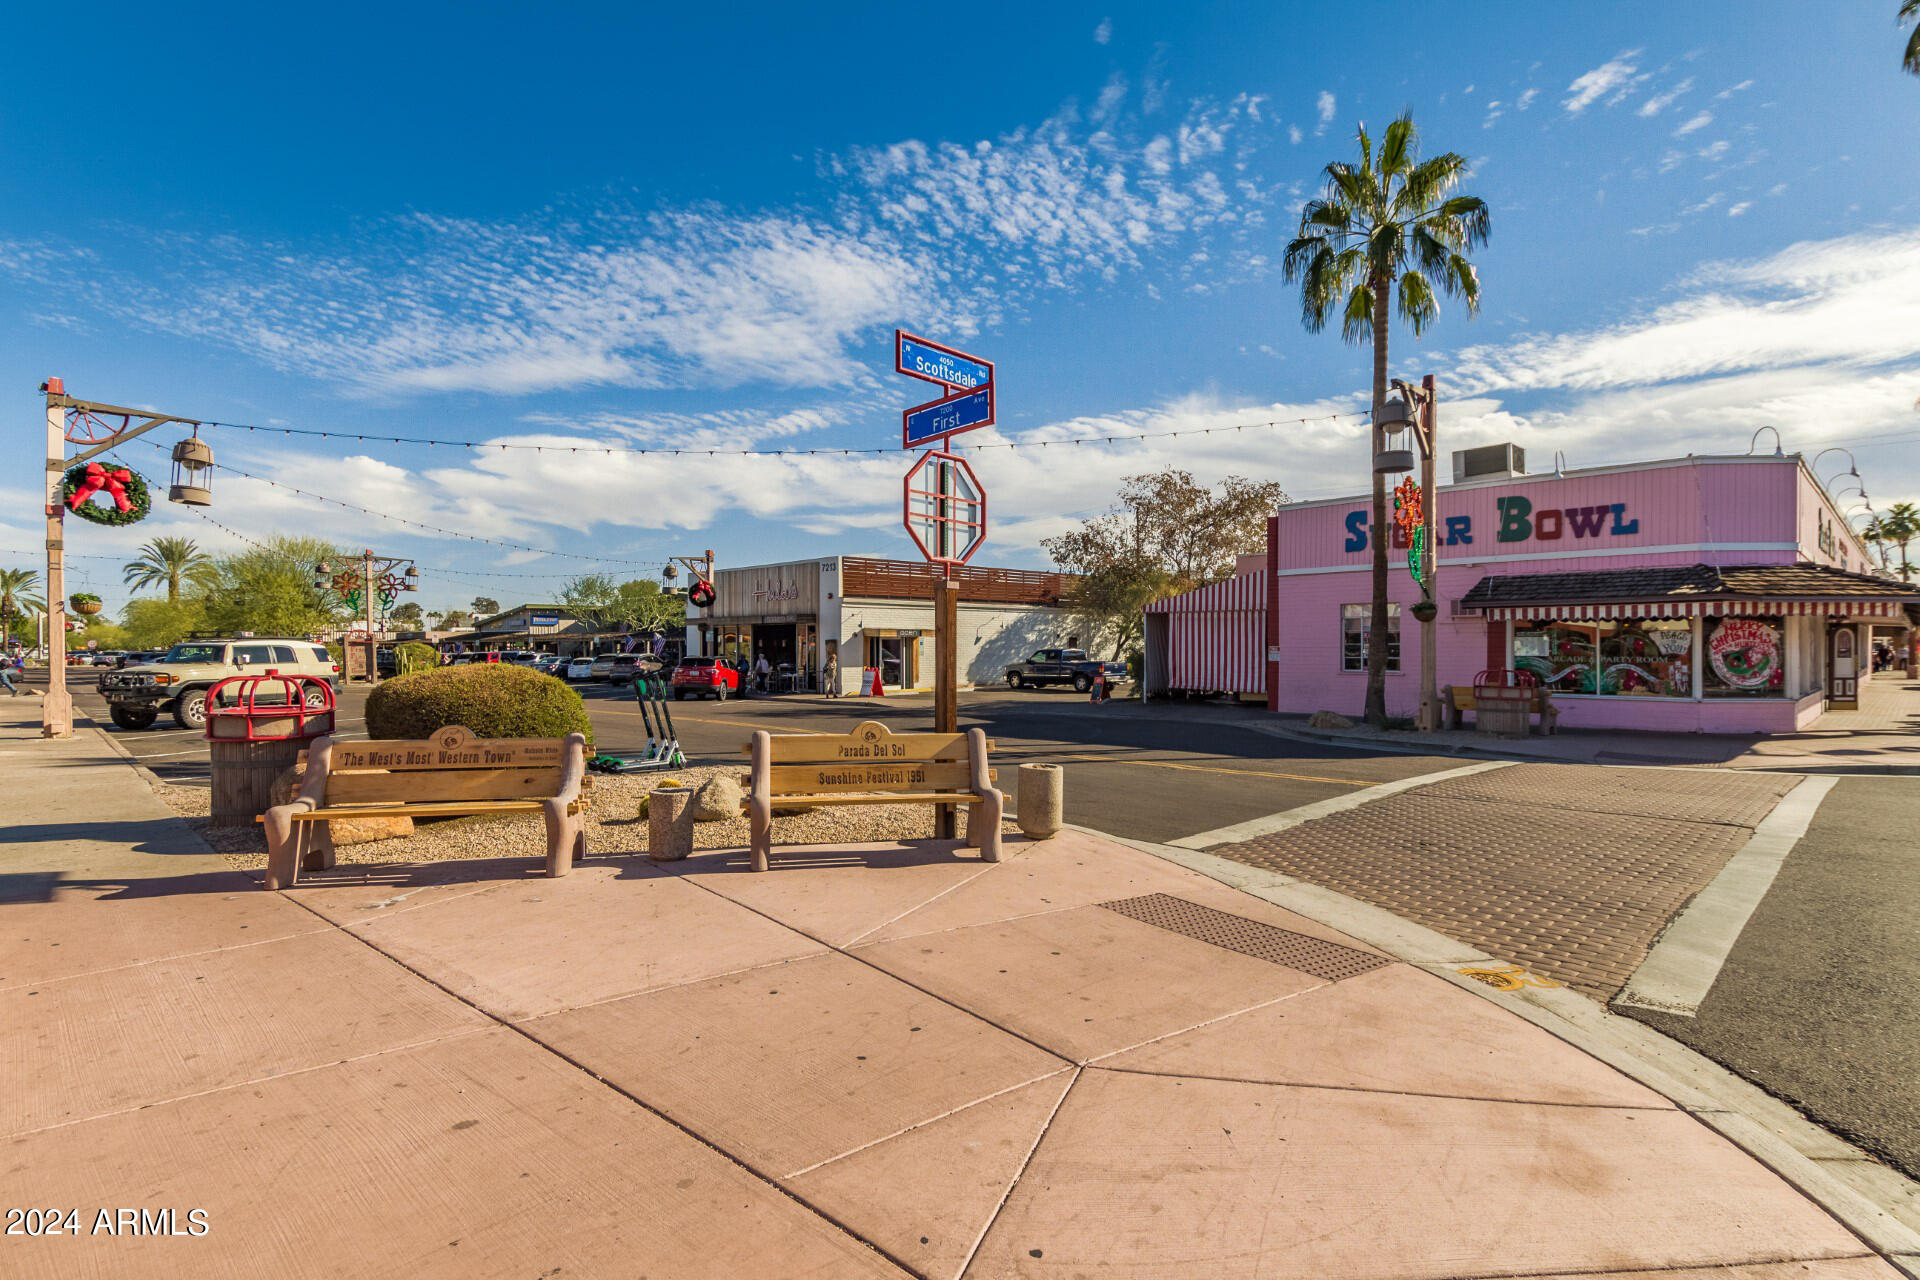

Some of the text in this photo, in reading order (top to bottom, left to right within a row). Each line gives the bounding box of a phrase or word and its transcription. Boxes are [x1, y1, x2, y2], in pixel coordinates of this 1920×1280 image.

[939, 357, 954, 366] 4050
[916, 356, 986, 388] Scottsdale Rd
[974, 395, 985, 404] Ave
[932, 412, 961, 432] First
[1497, 495, 1639, 543] BOWL
[821, 563, 836, 572] 7213
[1709, 629, 1772, 650] CHRISTMAS
[368, 751, 402, 765] West's
[406, 750, 433, 765] Most
[438, 750, 479, 764] Western
[838, 743, 906, 757] Parada Del Sol
[818, 770, 926, 785] Sunshine Festival 1951
